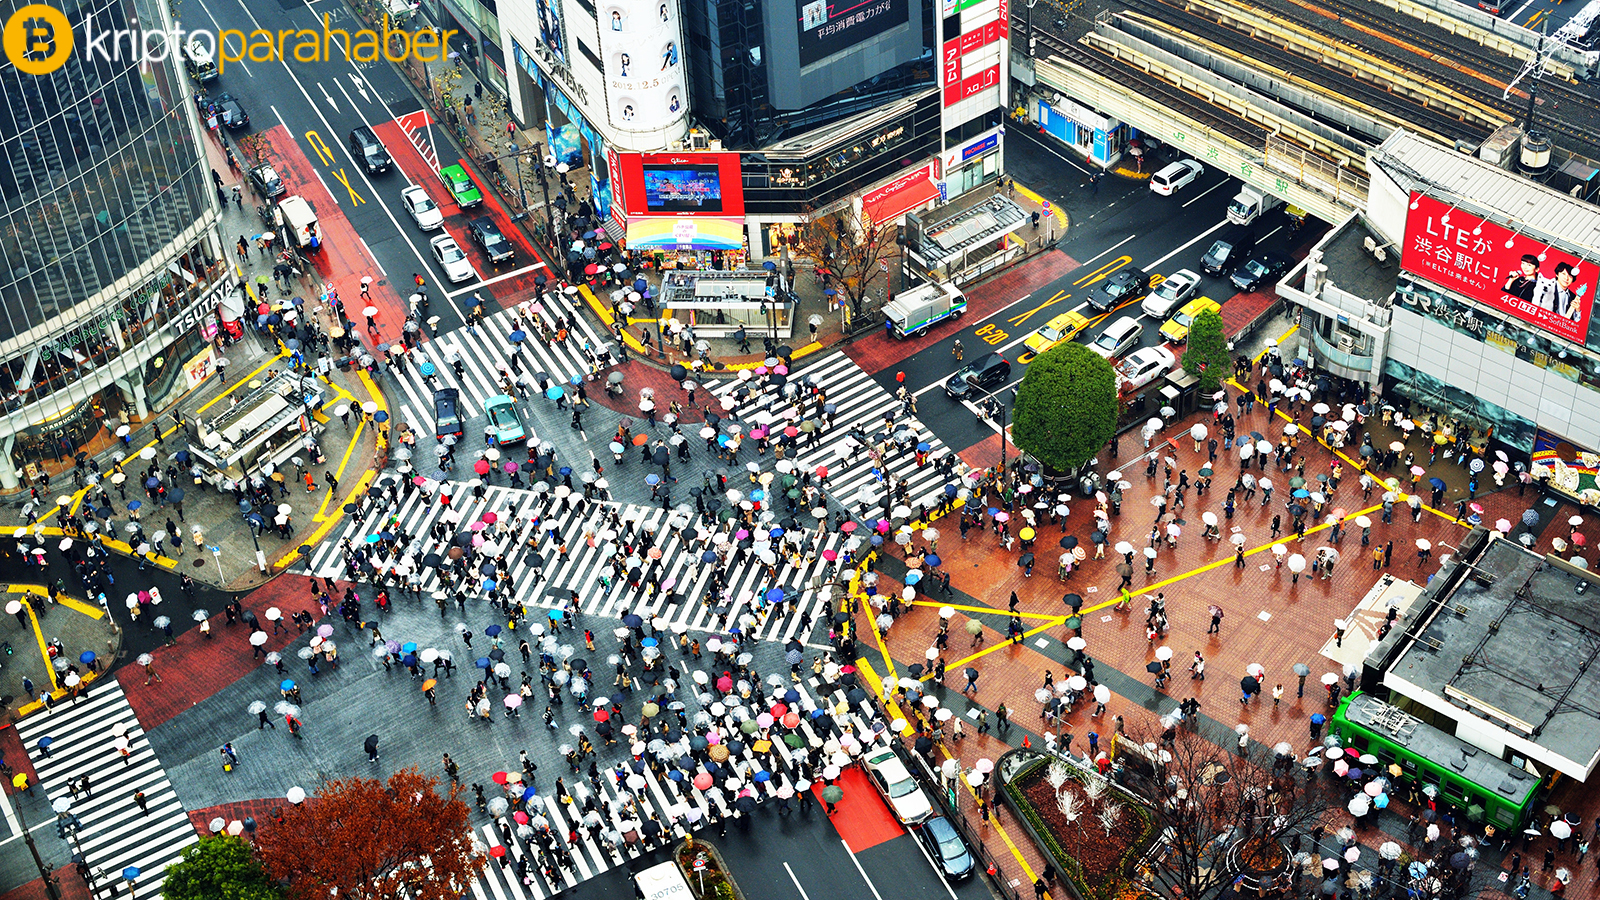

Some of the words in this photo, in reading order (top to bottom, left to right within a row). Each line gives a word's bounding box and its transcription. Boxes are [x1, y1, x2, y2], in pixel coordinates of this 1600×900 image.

[946, 48, 957, 82] アコム
[612, 78, 660, 91] 2012.12.5
[966, 83, 979, 95] 入口
[670, 157, 689, 165] Glico
[1206, 145, 1289, 194] 渋谷駅
[1426, 216, 1493, 255] LTEが
[175, 279, 234, 335] TSUTAYA
[1402, 292, 1432, 313] JR
[1433, 304, 1484, 334] 渋谷駅
[1500, 294, 1519, 308] 4G
[1519, 301, 1537, 315] LTE
[974, 323, 1009, 346] 8-20
[1548, 315, 1578, 334] SoftBank
